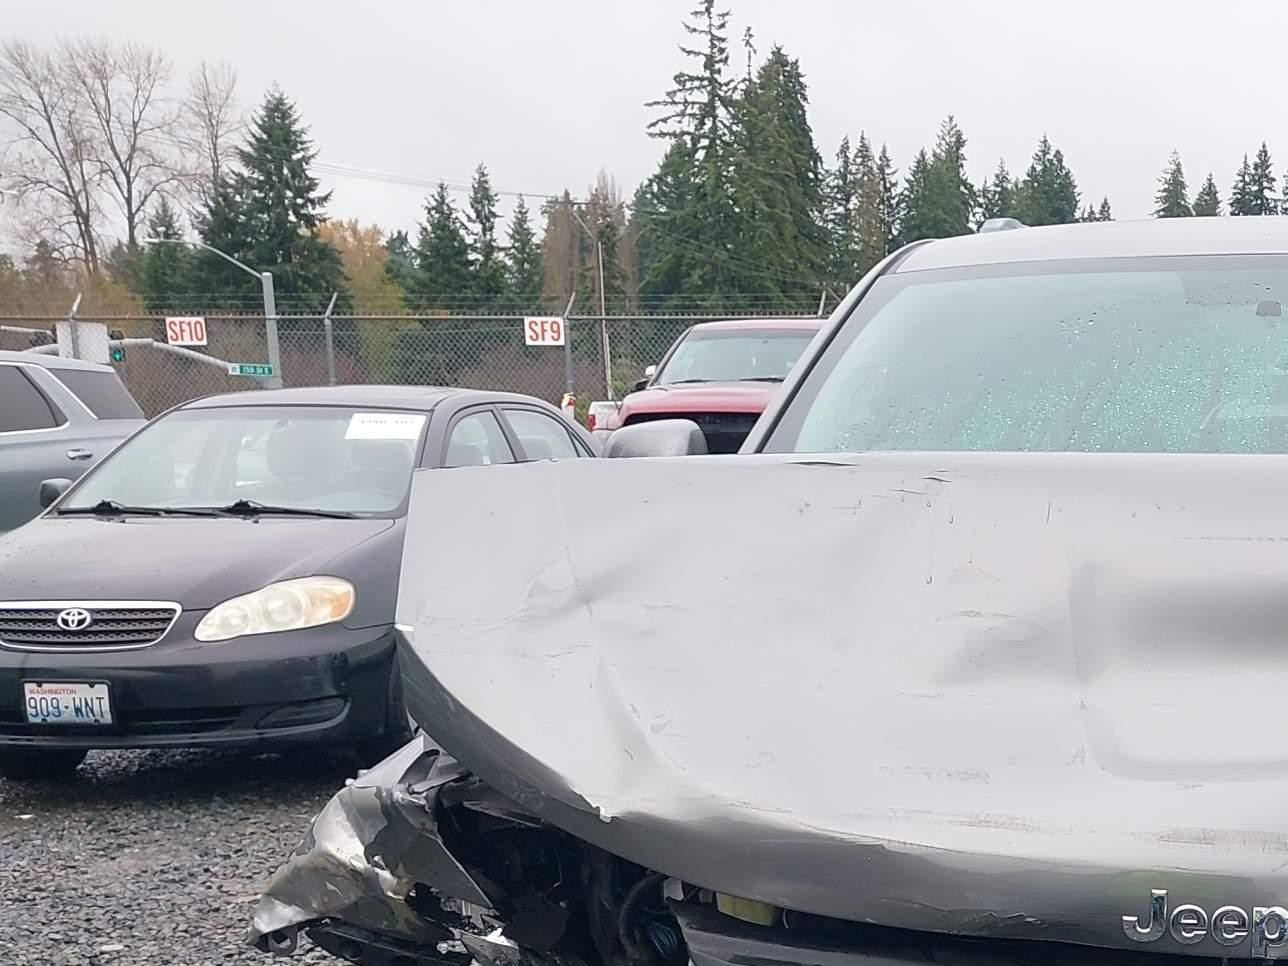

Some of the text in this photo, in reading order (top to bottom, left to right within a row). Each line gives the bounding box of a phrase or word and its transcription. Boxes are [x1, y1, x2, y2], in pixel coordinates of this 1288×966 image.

[168, 320, 205, 342] SF10
[528, 320, 561, 342] SF9
[28, 688, 77, 696] WASHINGTON
